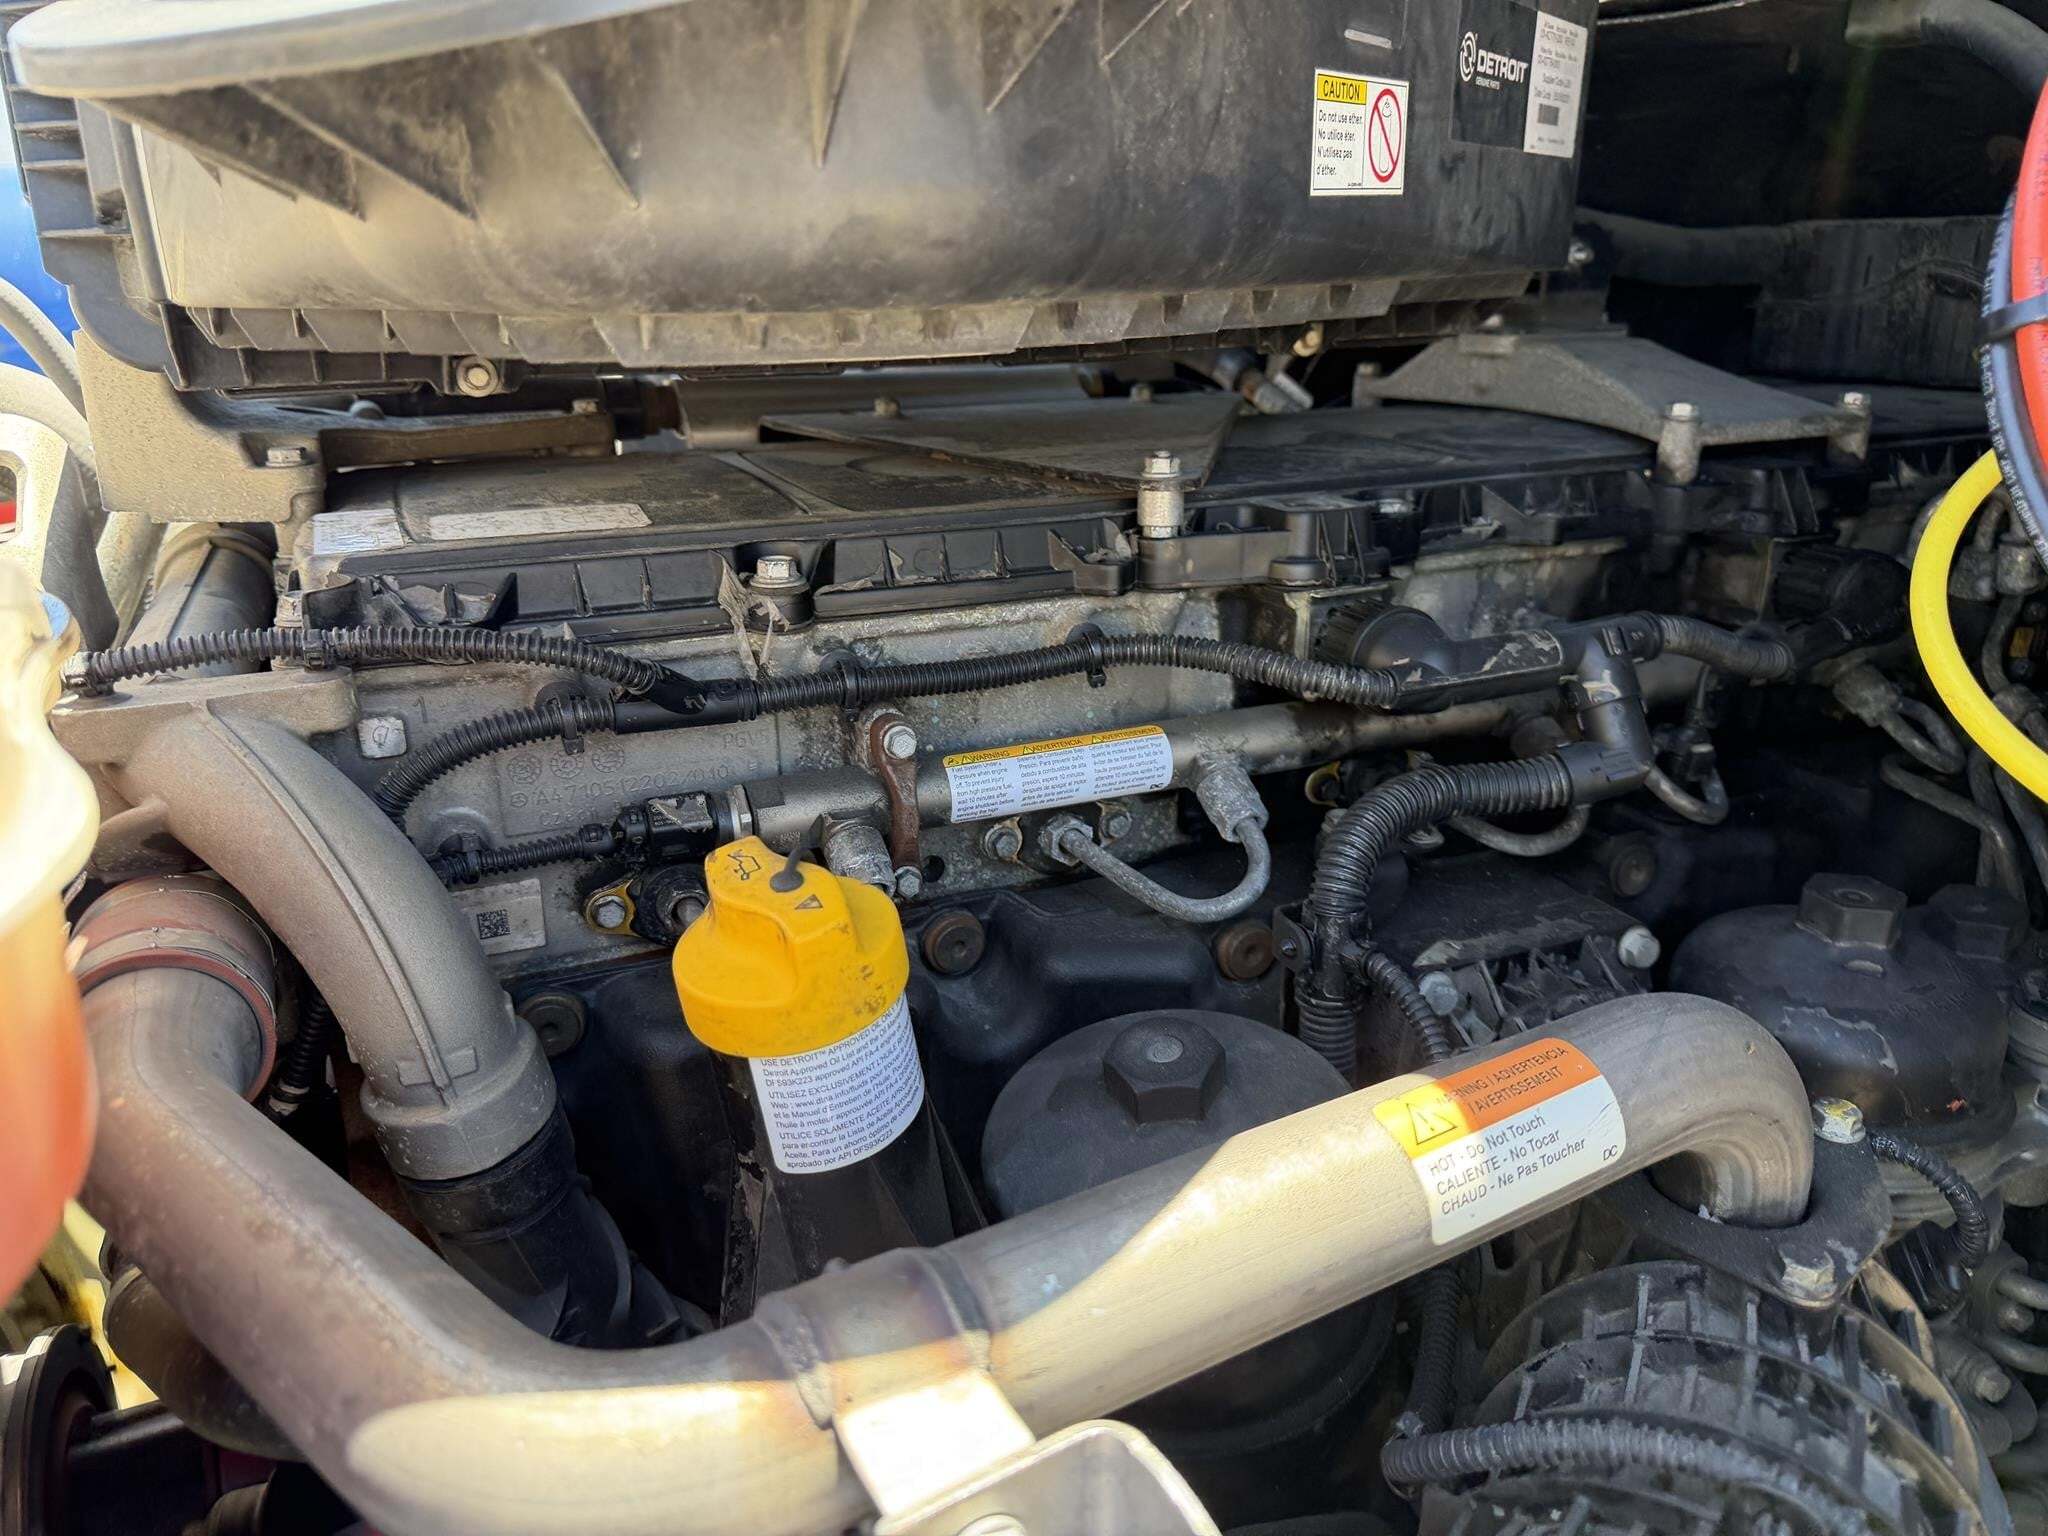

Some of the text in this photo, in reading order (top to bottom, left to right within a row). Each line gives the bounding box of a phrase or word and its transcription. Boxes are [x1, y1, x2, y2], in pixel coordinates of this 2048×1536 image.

[1477, 49, 1529, 83] DETROIT
[1323, 80, 1360, 100] CAUTION
[1319, 109, 1326, 121] Do
[1328, 112, 1337, 122] not
[1339, 114, 1348, 124] use
[1318, 129, 1326, 140] No
[1327, 129, 1343, 141] utilice
[1317, 145, 1352, 161] N'utilisez pas
[971, 750, 1010, 762] WARNING
[1033, 739, 1082, 752] ADVERTENCIA
[761, 1059, 778, 1067] USE
[828, 1029, 871, 1055] APPROVED
[763, 1068, 788, 1077] Detroit
[790, 1062, 828, 1077] Approved
[830, 1056, 841, 1067] Oil
[842, 1048, 856, 1062] List
[856, 1041, 871, 1055] and
[870, 1033, 880, 1046] the
[815, 1066, 850, 1082] approved
[852, 1055, 864, 1068] API
[865, 1044, 880, 1058] FA-4
[768, 1089, 807, 1099] UTILISEZ
[808, 1063, 875, 1097] EXCLUSIVEMENT
[1495, 1047, 1568, 1085] ADVERTENCIA
[771, 1101, 789, 1109] Web
[869, 1069, 884, 1085] pour
[783, 1111, 790, 1119] le
[792, 1107, 821, 1119] Manuel
[863, 1086, 872, 1097] de
[1477, 1065, 1564, 1113] AVERTISSEMENT
[780, 1100, 891, 1141] UTILICE SOLAMENTE ACEITE
[807, 1115, 834, 1128] moteur
[873, 1090, 885, 1104] API
[782, 1142, 799, 1151] para
[838, 1133, 846, 1142] la
[847, 1126, 865, 1138] Lista
[866, 1118, 876, 1130] de
[784, 1150, 810, 1160] Aceite.
[811, 1148, 831, 1158] Para
[832, 1145, 843, 1154] un
[843, 1136, 868, 1150] ahorro
[1430, 1113, 1547, 1176] HOT Do Not Touch
[787, 1160, 823, 1169] aprobado
[824, 1157, 837, 1168] por
[838, 1151, 852, 1162] API
[1437, 1128, 1561, 1195] CALIENTE No Tocar
[1602, 1144, 1619, 1162] DC
[1441, 1137, 1586, 1216] CHAUD Ne Pas Toucher
